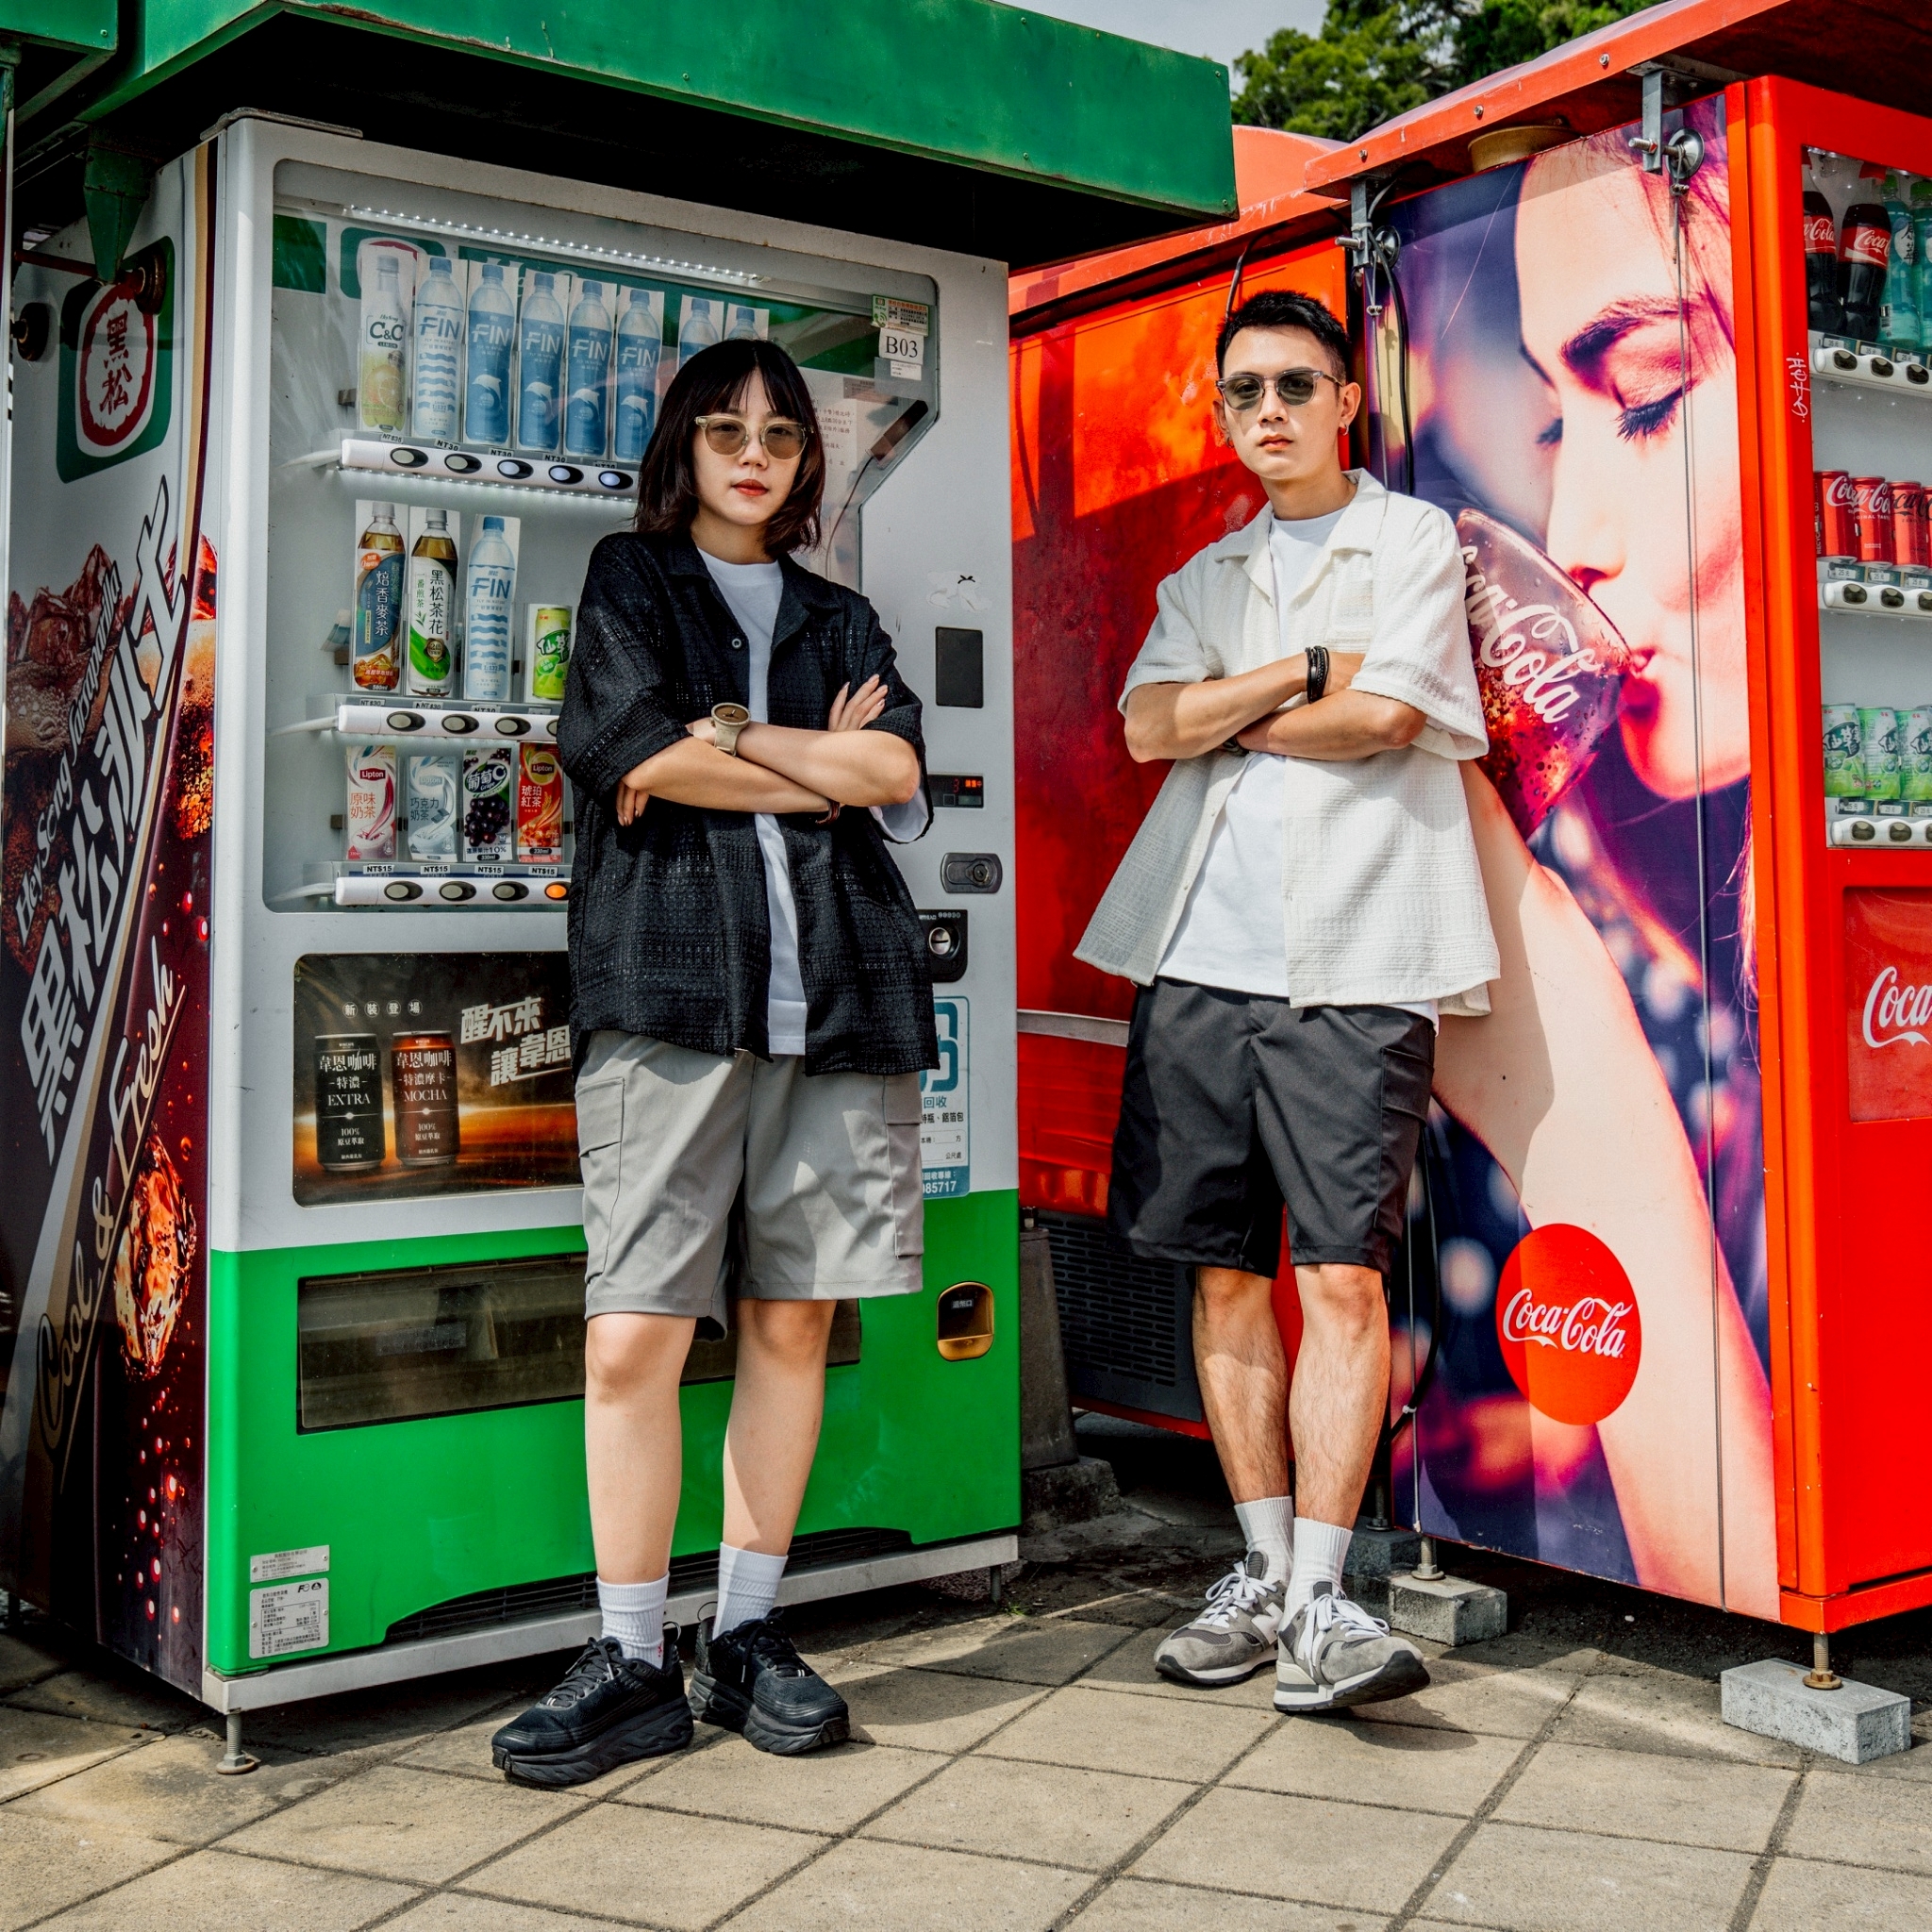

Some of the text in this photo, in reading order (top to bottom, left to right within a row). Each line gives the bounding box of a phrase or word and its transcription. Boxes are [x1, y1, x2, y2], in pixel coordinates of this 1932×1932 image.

[370, 321, 405, 341] C&C
[418, 316, 461, 341] FIN
[472, 324, 509, 347] FIN
[525, 332, 560, 354] FIN
[572, 340, 608, 361] FIN
[885, 336, 918, 358] B03
[100, 309, 132, 415] 黑松
[620, 346, 656, 368] FIN
[437, 440, 458, 451] NT30
[544, 455, 566, 463] NT30
[471, 577, 511, 599] FIN
[375, 570, 391, 636] 焙香麥茶
[428, 569, 444, 635] 黑松茶花
[361, 770, 384, 779] Lipton
[532, 764, 553, 773] Lipton
[480, 782, 495, 791] Grape
[521, 785, 542, 797] 琥珀
[350, 792, 376, 806] 原味
[410, 797, 440, 809] 巧克力
[521, 796, 541, 808] 紅茶
[350, 806, 376, 820] 奶茶
[410, 809, 429, 821] 奶茶
[343, 1000, 423, 1018] 新裝登場
[460, 996, 541, 1044] 醒不來
[109, 934, 174, 1189] Fresh
[320, 1053, 377, 1073] 韋恩咖啡
[397, 1050, 452, 1069] 韋恩咖啡
[491, 1025, 571, 1087] 讓韋恩
[327, 1093, 371, 1107] EXTRA
[404, 1090, 448, 1102] MOCHA
[924, 1095, 947, 1108] 回收
[341, 1127, 360, 1136] 100%
[418, 1123, 437, 1131] 100%
[337, 1137, 364, 1146] 原豆萃取
[415, 1132, 441, 1141] 原豆萃取
[1503, 1289, 1633, 1358] Coca-Cola
